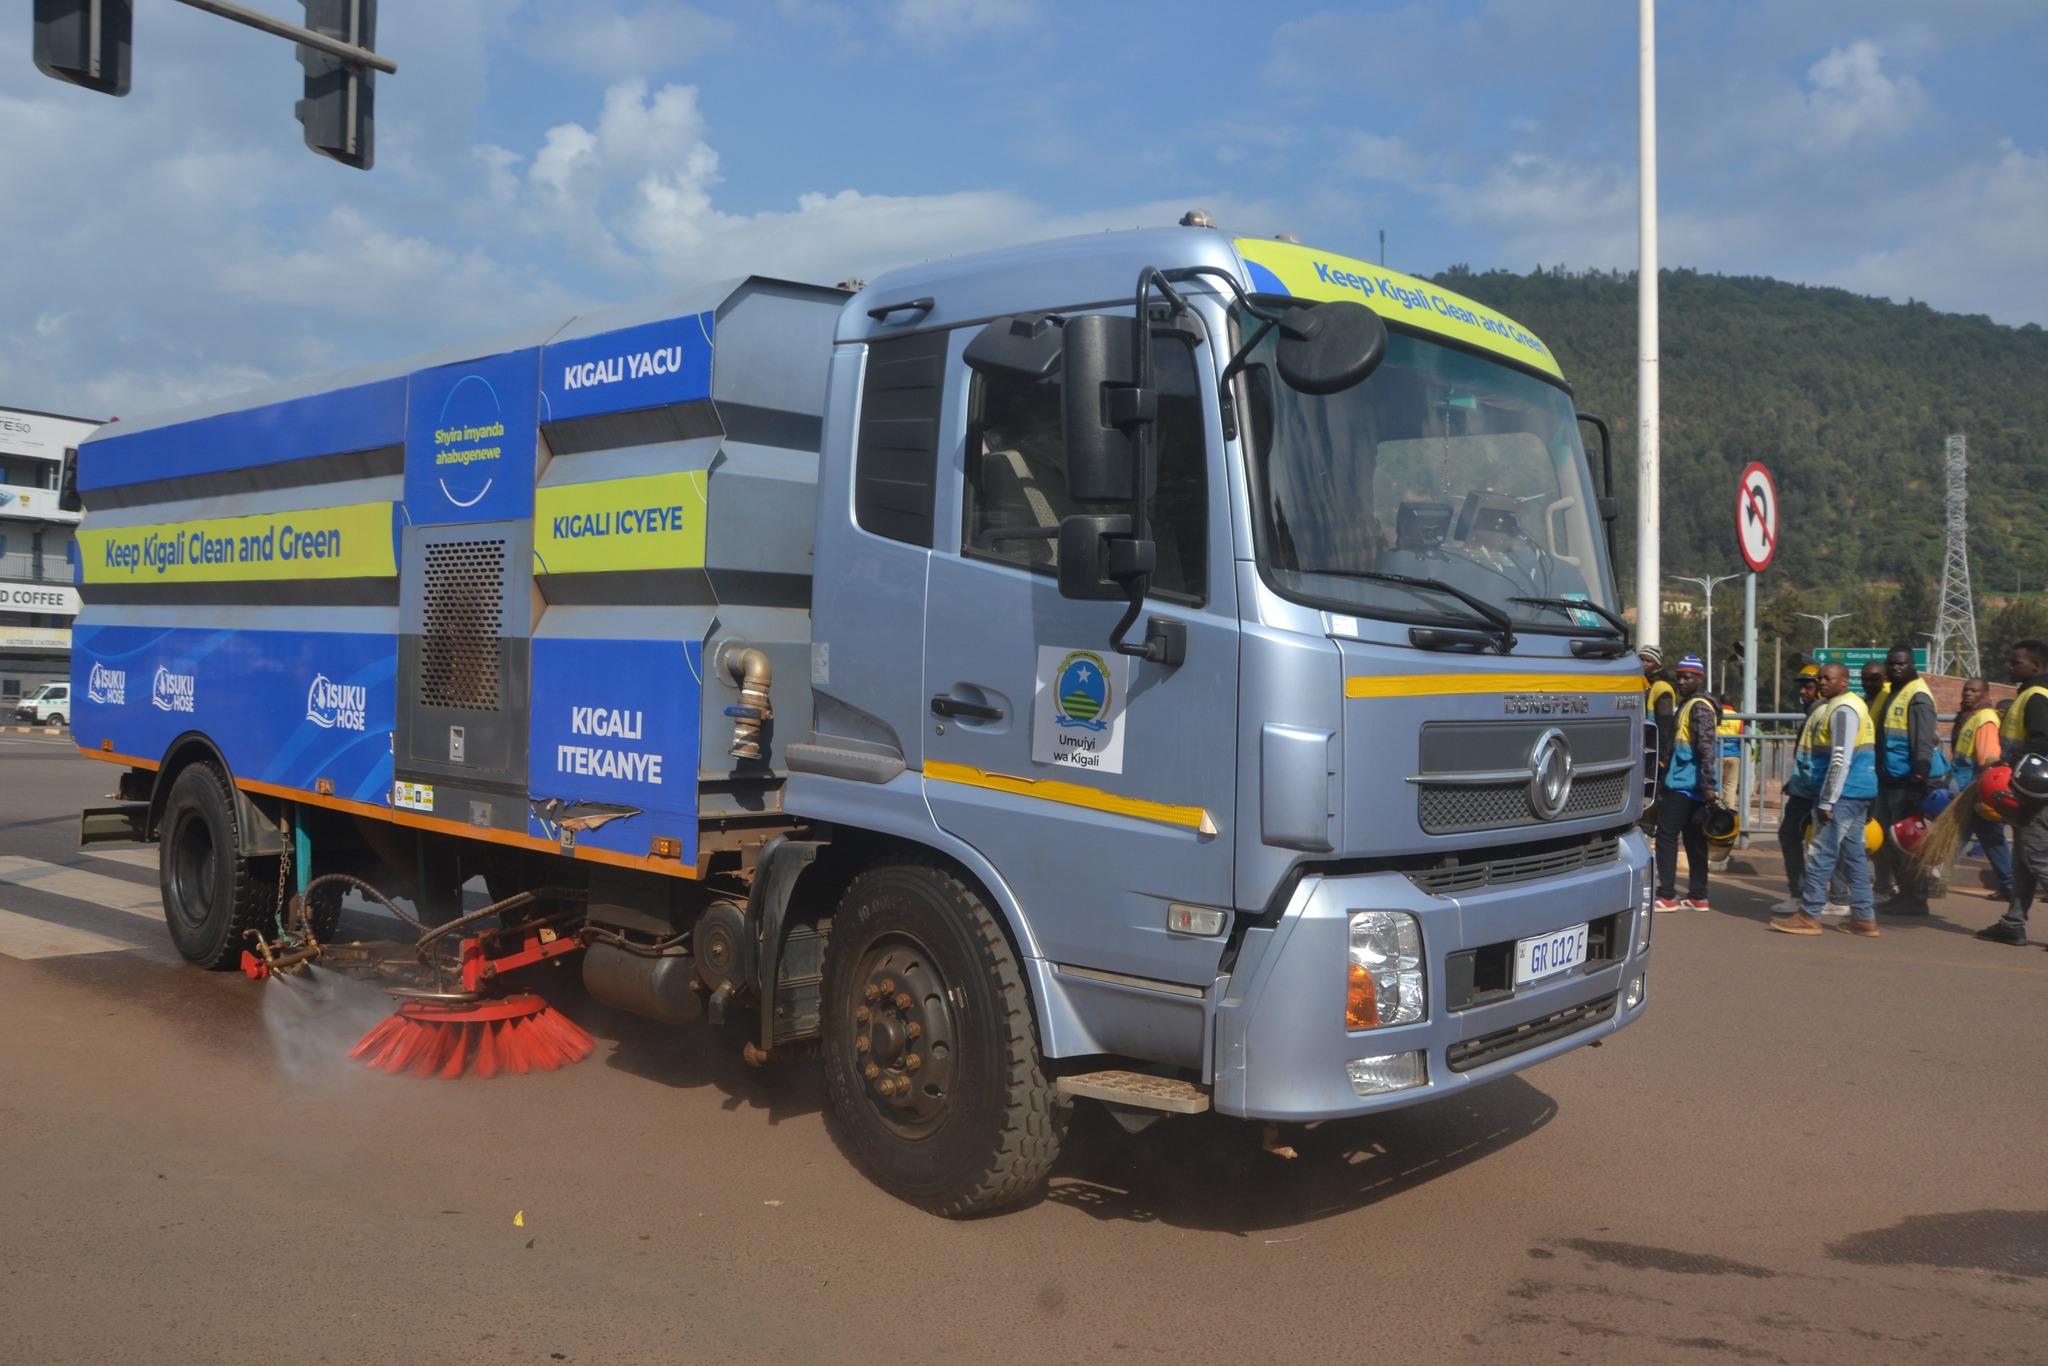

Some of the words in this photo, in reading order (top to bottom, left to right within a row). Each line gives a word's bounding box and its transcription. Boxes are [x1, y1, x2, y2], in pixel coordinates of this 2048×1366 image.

[1313, 261, 1375, 298] Keep
[1374, 276, 1432, 311] Kigali
[1431, 295, 1481, 328] Clean
[1480, 315, 1511, 339] and
[1508, 324, 1547, 357] Green
[564, 357, 624, 390] KIGALI
[627, 346, 682, 379] YACU
[435, 426, 463, 446] Shyira
[464, 421, 505, 443] imyanda
[436, 447, 501, 465] ahabugenewe
[553, 512, 610, 539] KIGALI
[615, 506, 683, 535] ICYEYE
[106, 539, 140, 574] Keep
[143, 530, 185, 574] Kigali
[189, 531, 234, 565] Clean
[239, 525, 275, 562] and
[279, 525, 340, 560] Green
[13, 591, 64, 606] COFFEE
[101, 669, 125, 690] ISUKU
[165, 673, 194, 696] ISUKU
[107, 689, 125, 705] HOSE
[174, 695, 194, 712] HOSE
[325, 683, 366, 711] ISUKU
[1504, 695, 1589, 714] DONGFENG
[337, 709, 366, 731] HOSE
[572, 706, 643, 740] KIGALI
[1059, 734, 1096, 751] Umujyi
[557, 744, 663, 785] ITEKANYE
[1053, 752, 1069, 762] wa
[1071, 752, 1100, 767] Kigali
[1531, 942, 1548, 974] GR
[1551, 935, 1575, 968] 012
[1576, 931, 1584, 960] F
